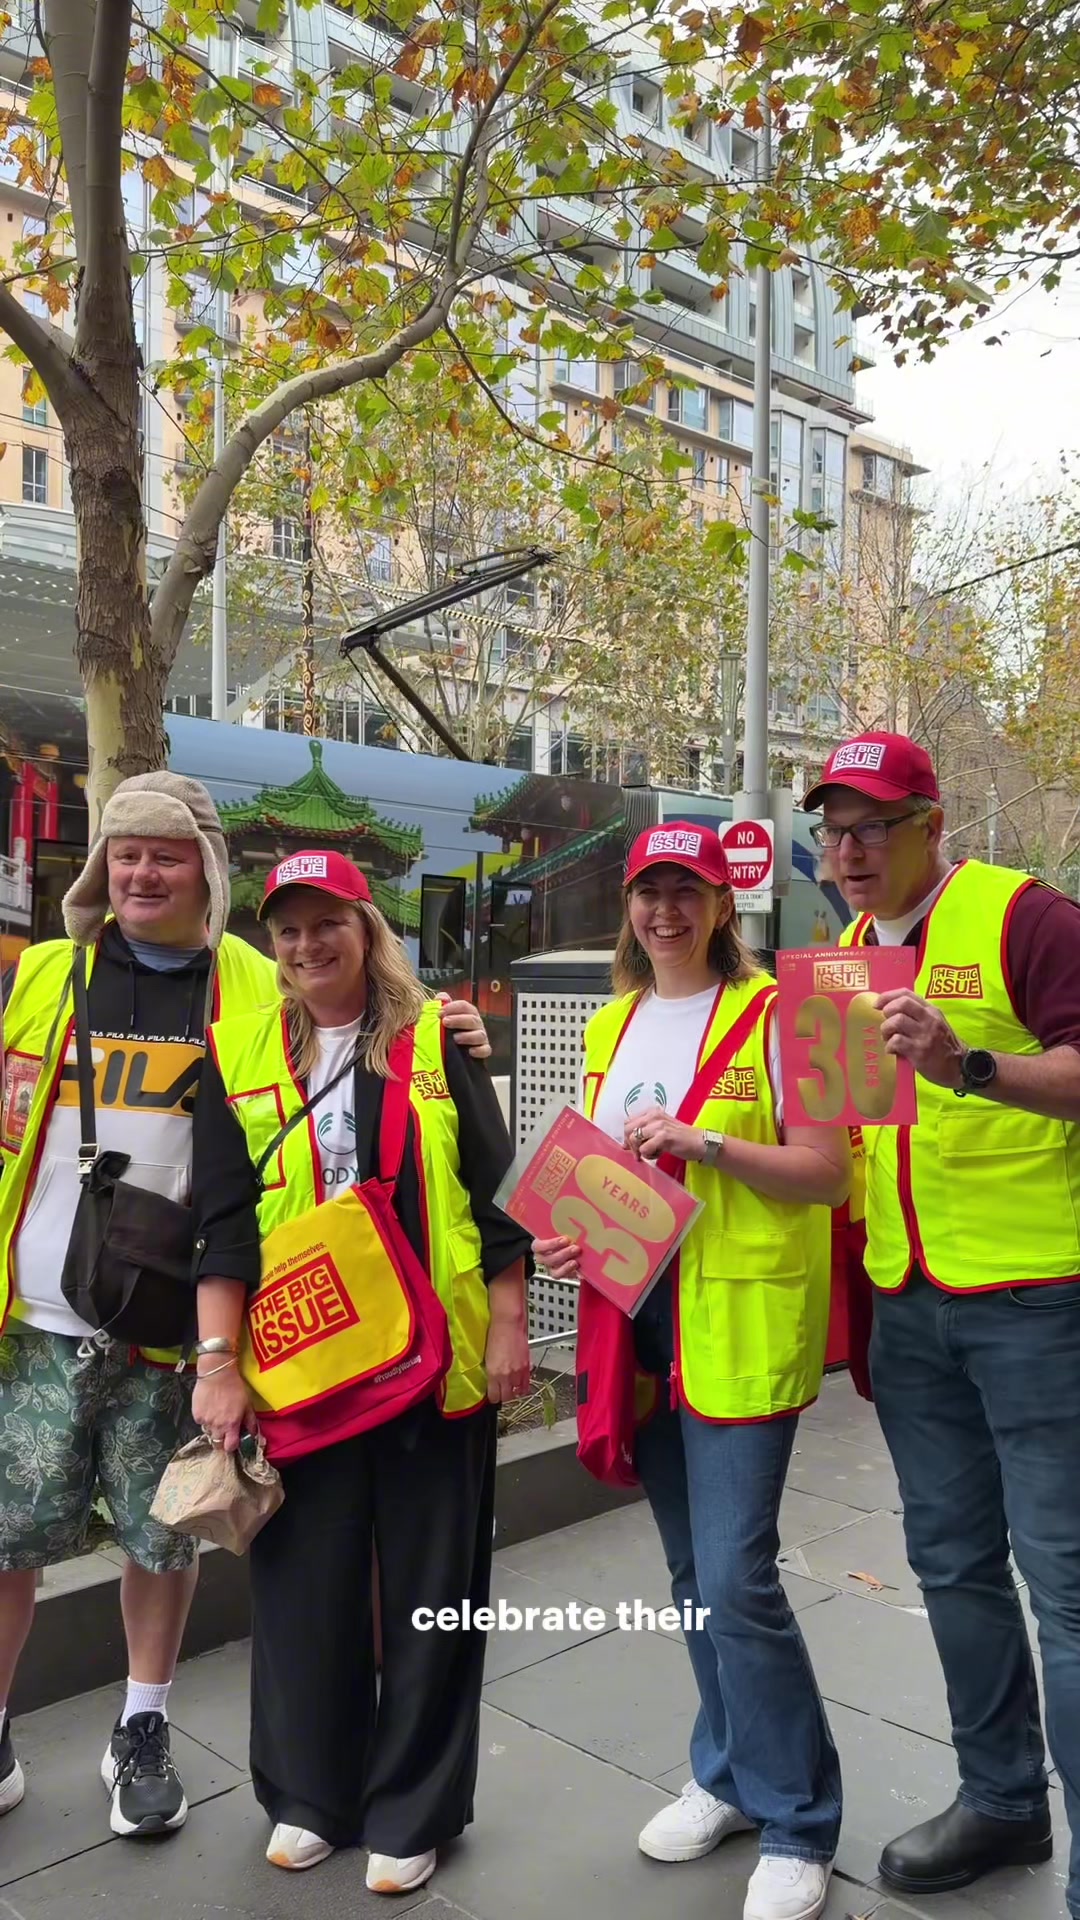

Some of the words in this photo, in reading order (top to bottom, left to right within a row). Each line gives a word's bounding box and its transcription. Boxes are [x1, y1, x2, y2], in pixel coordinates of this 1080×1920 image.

[858, 744, 880, 754] BIG
[652, 832, 674, 841] THE
[675, 832, 697, 841] BIG
[737, 830, 754, 845] NO
[650, 839, 697, 853] ISSUE
[279, 859, 300, 872] THE
[301, 857, 323, 865] BIG
[279, 864, 323, 881] ISSUE
[818, 965, 842, 975] THE
[844, 964, 865, 973] BIG
[933, 969, 955, 979] THE
[957, 970, 978, 980] BIG
[818, 973, 865, 988] ISSUE
[930, 979, 979, 995] ISSUE
[106, 1031, 125, 1039] FILA
[127, 1033, 145, 1041] FILA
[795, 991, 898, 1122] 30
[862, 1025, 882, 1089] YEARS
[412, 1073, 430, 1084] HE
[735, 1071, 754, 1081] BIG
[414, 1081, 450, 1097] SSU
[711, 1080, 756, 1096] SSUE
[548, 1150, 563, 1171] BIG
[322, 1166, 361, 1186] ODY
[601, 1175, 651, 1220] YEARS
[551, 1154, 677, 1287] 30
[274, 1261, 288, 1275] help
[287, 1241, 328, 1266] themselves.
[250, 1289, 288, 1325] THE
[287, 1268, 332, 1303] BIG
[255, 1286, 347, 1360] ISSUE
